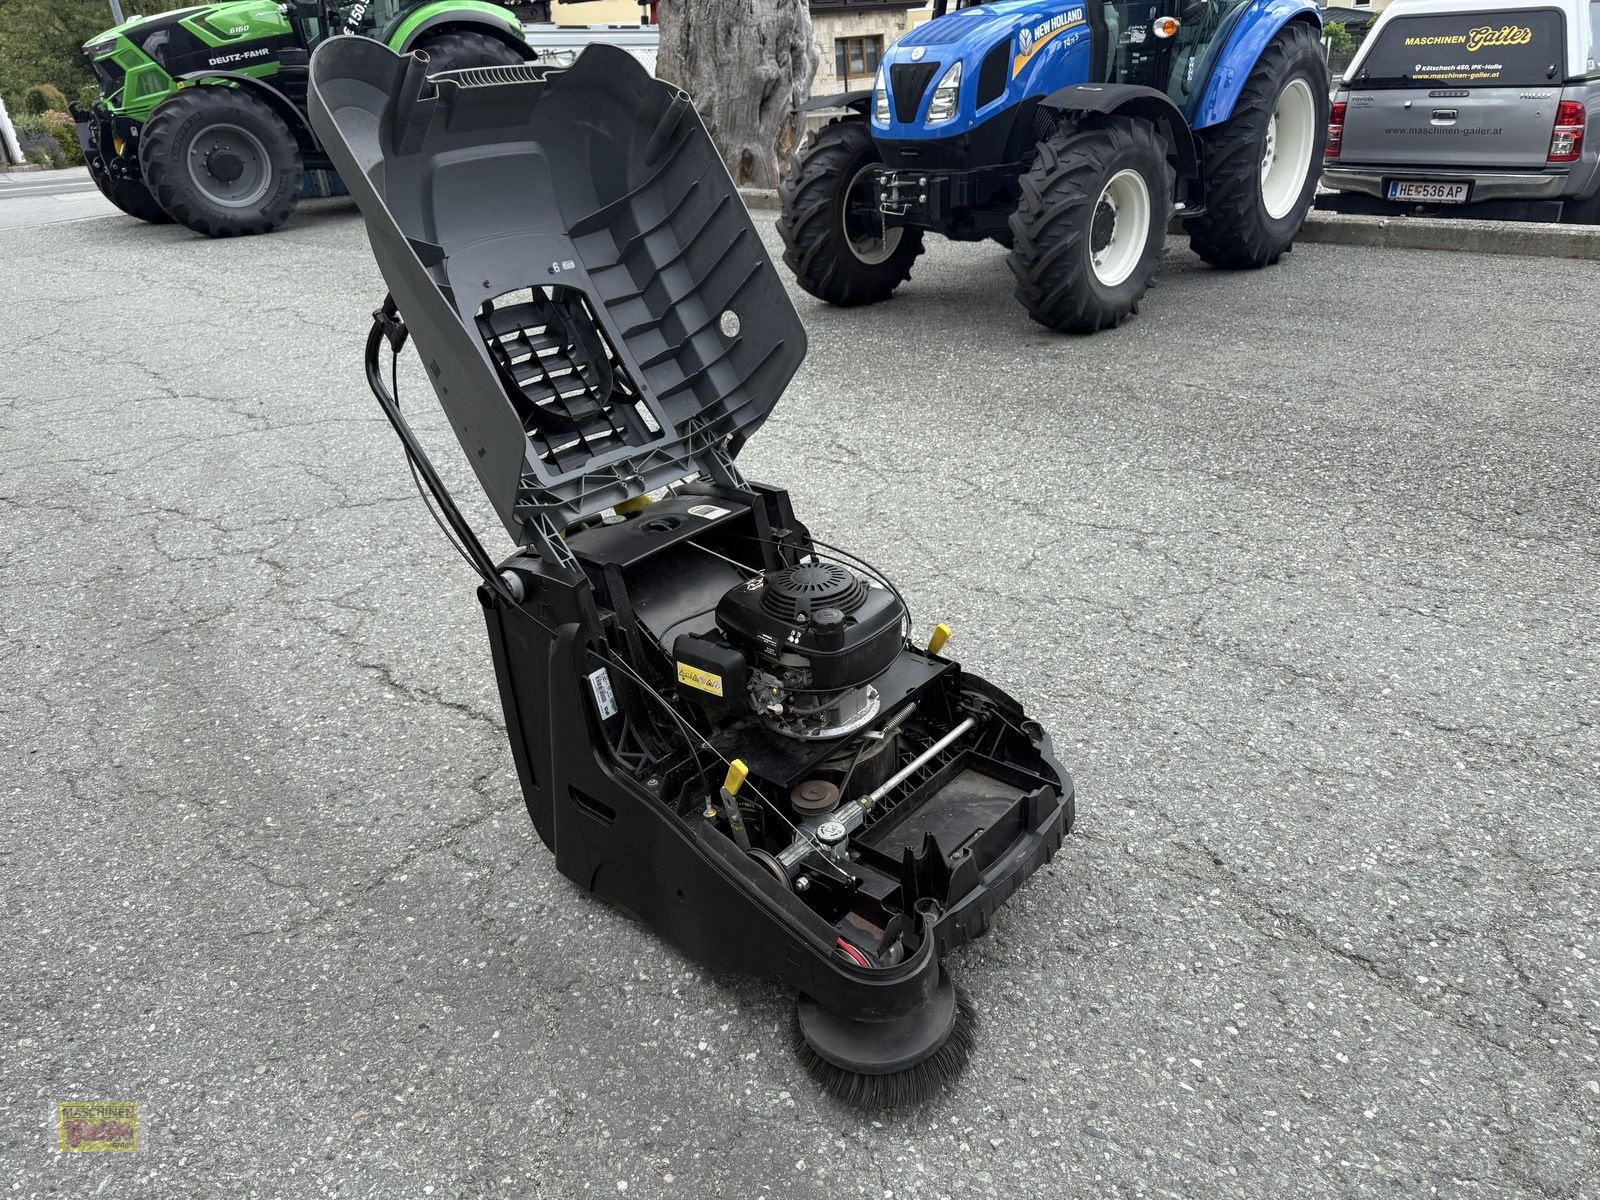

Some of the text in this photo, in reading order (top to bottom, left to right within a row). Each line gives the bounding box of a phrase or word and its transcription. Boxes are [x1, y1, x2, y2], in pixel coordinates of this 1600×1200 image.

[229, 25, 250, 34] 6160
[1034, 8, 1083, 41] NEW HOLLAND
[1405, 25, 1532, 52] MASCHINEN Gailer
[208, 48, 270, 66] DEUTZ-FAHR
[1412, 71, 1500, 80] www.maschinen-gailer.at
[1384, 127, 1503, 137] www.maschinen-gailer.at
